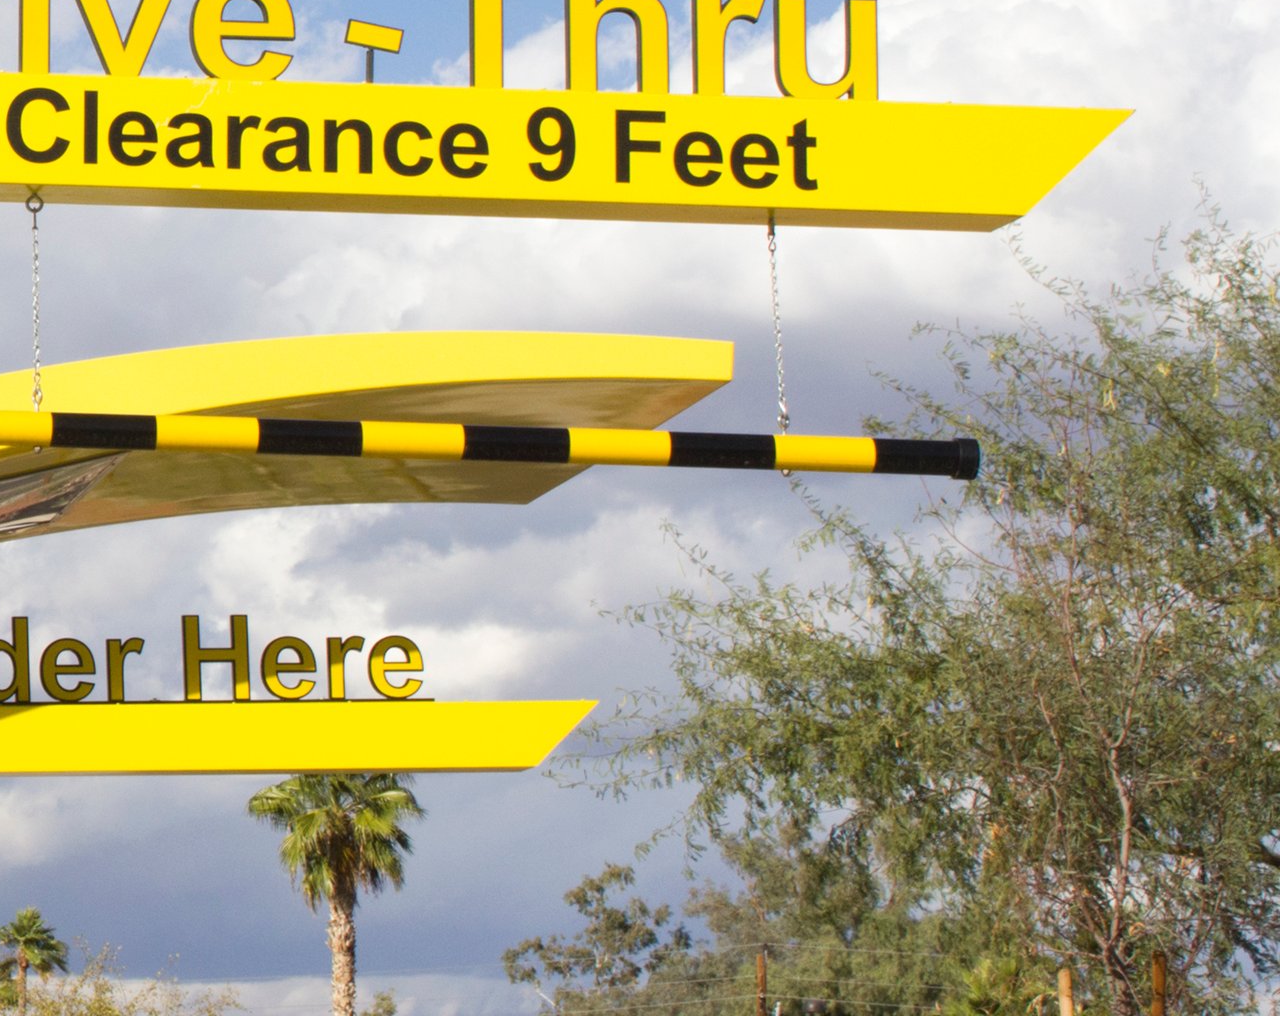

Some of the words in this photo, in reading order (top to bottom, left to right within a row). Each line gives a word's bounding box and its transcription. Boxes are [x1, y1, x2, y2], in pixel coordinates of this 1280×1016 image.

[6, 87, 490, 179] Clearance
[527, 106, 577, 181] 9
[614, 110, 819, 191] Feet
[182, 614, 425, 701] Here
